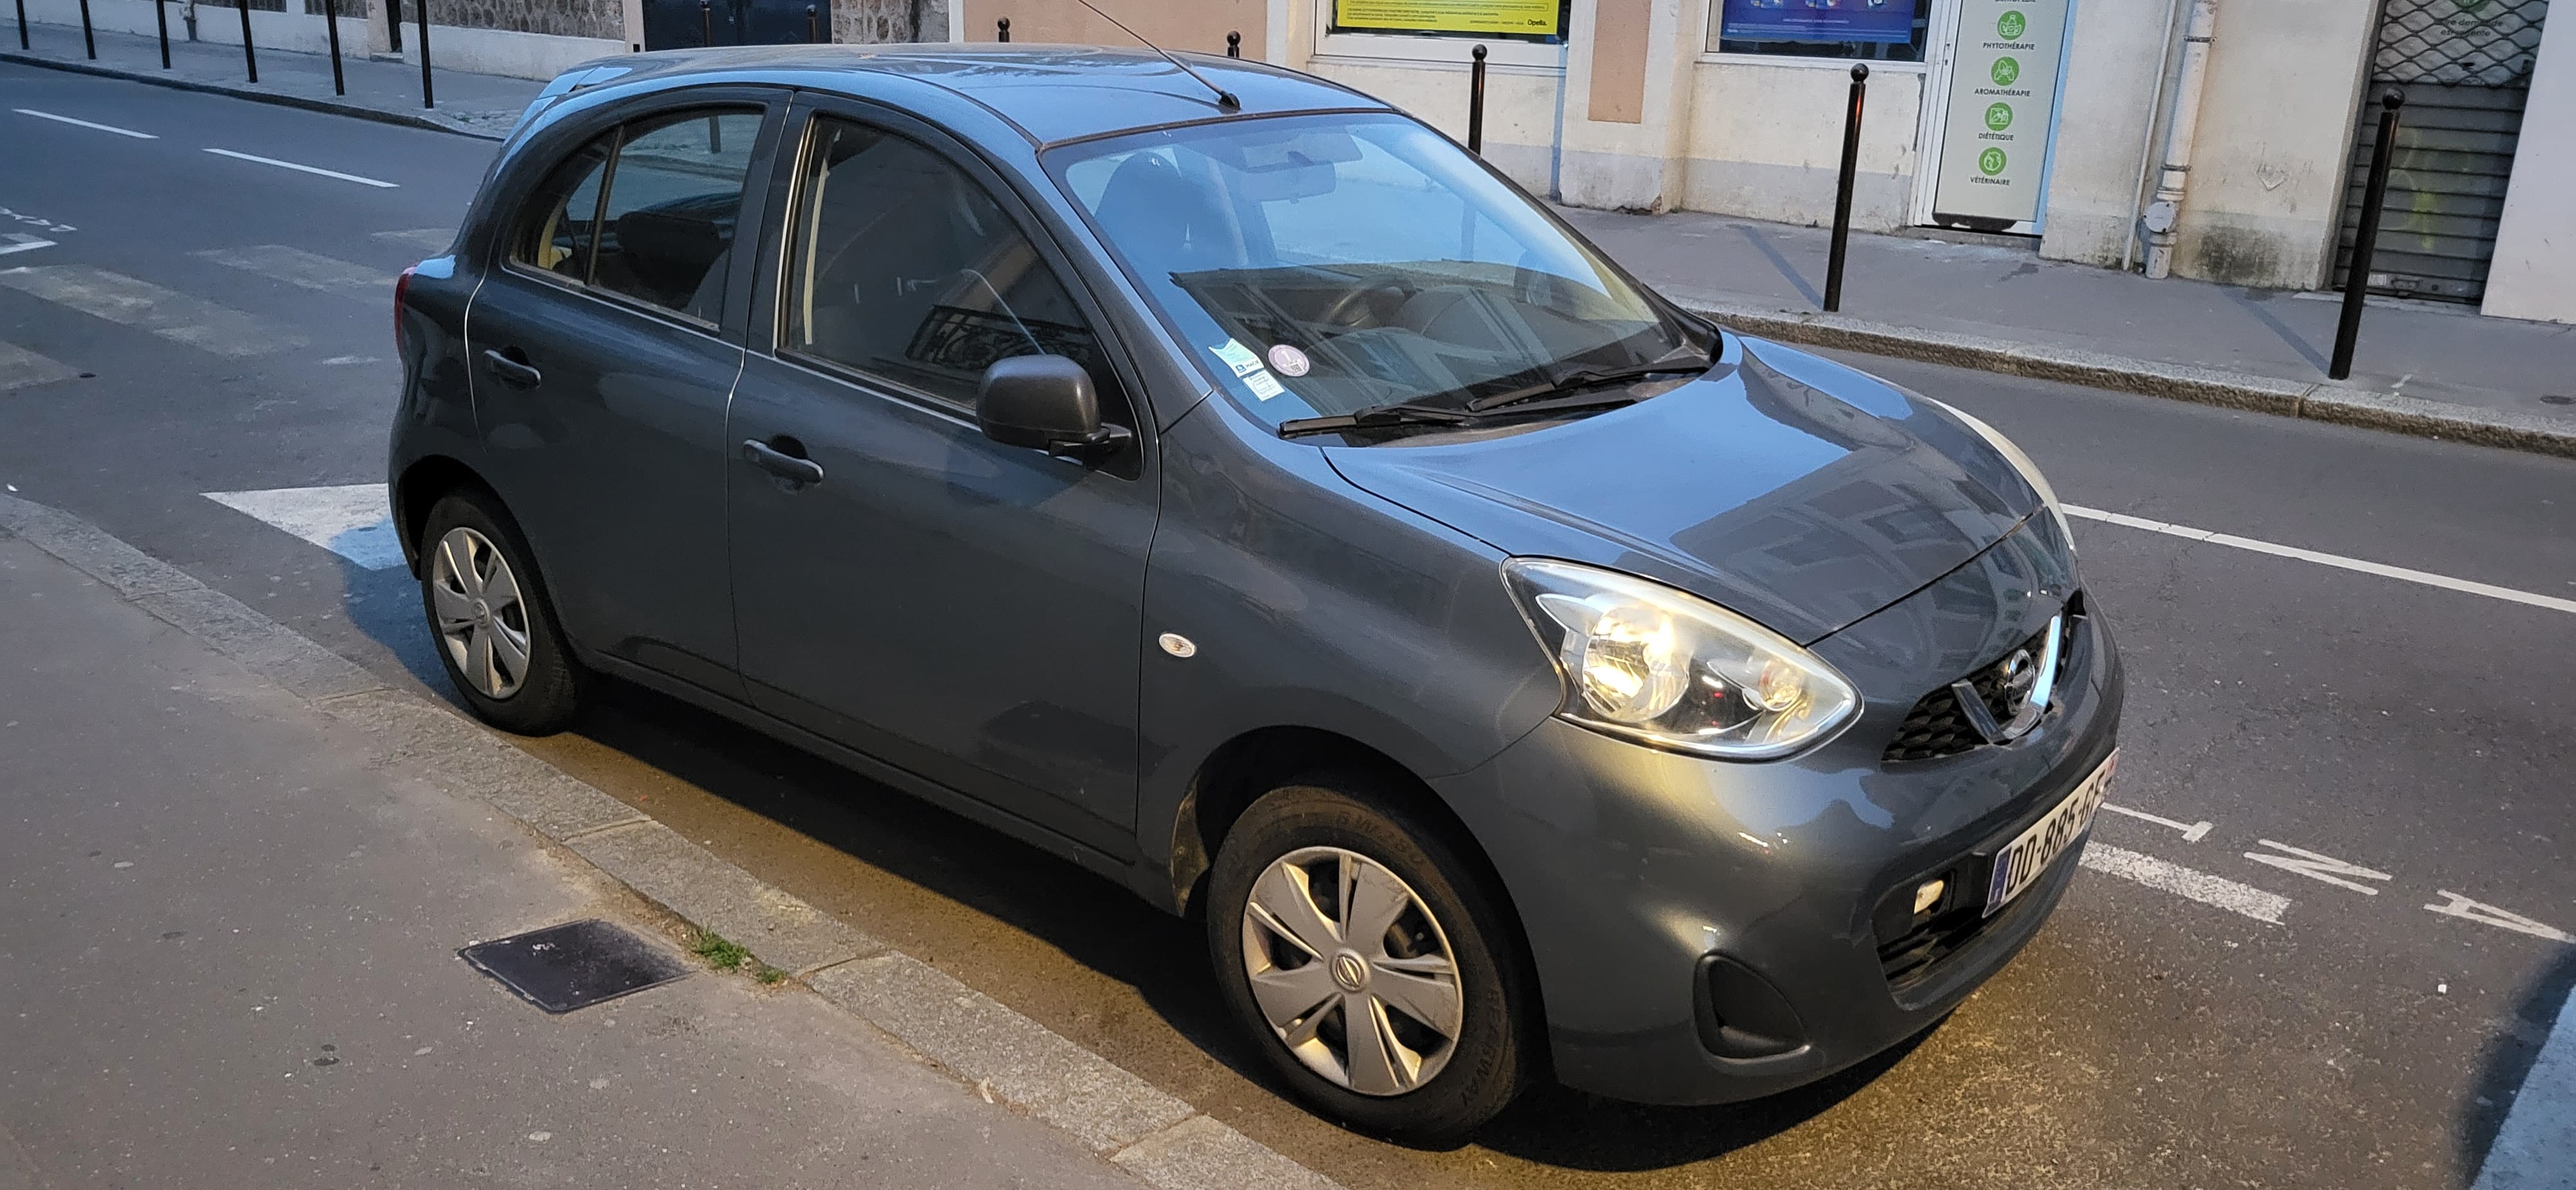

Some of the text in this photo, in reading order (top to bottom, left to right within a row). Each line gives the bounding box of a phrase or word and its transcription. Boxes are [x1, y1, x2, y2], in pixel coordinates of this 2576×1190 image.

[1982, 41, 2035, 50] PHYTOTHÉRAPIE
[1974, 88, 2031, 97] AROMATHÉRAPIE
[1978, 131, 2014, 141] DIÉTÉTIQUE
[1970, 176, 2011, 186] VÉTÉRINAIRE
